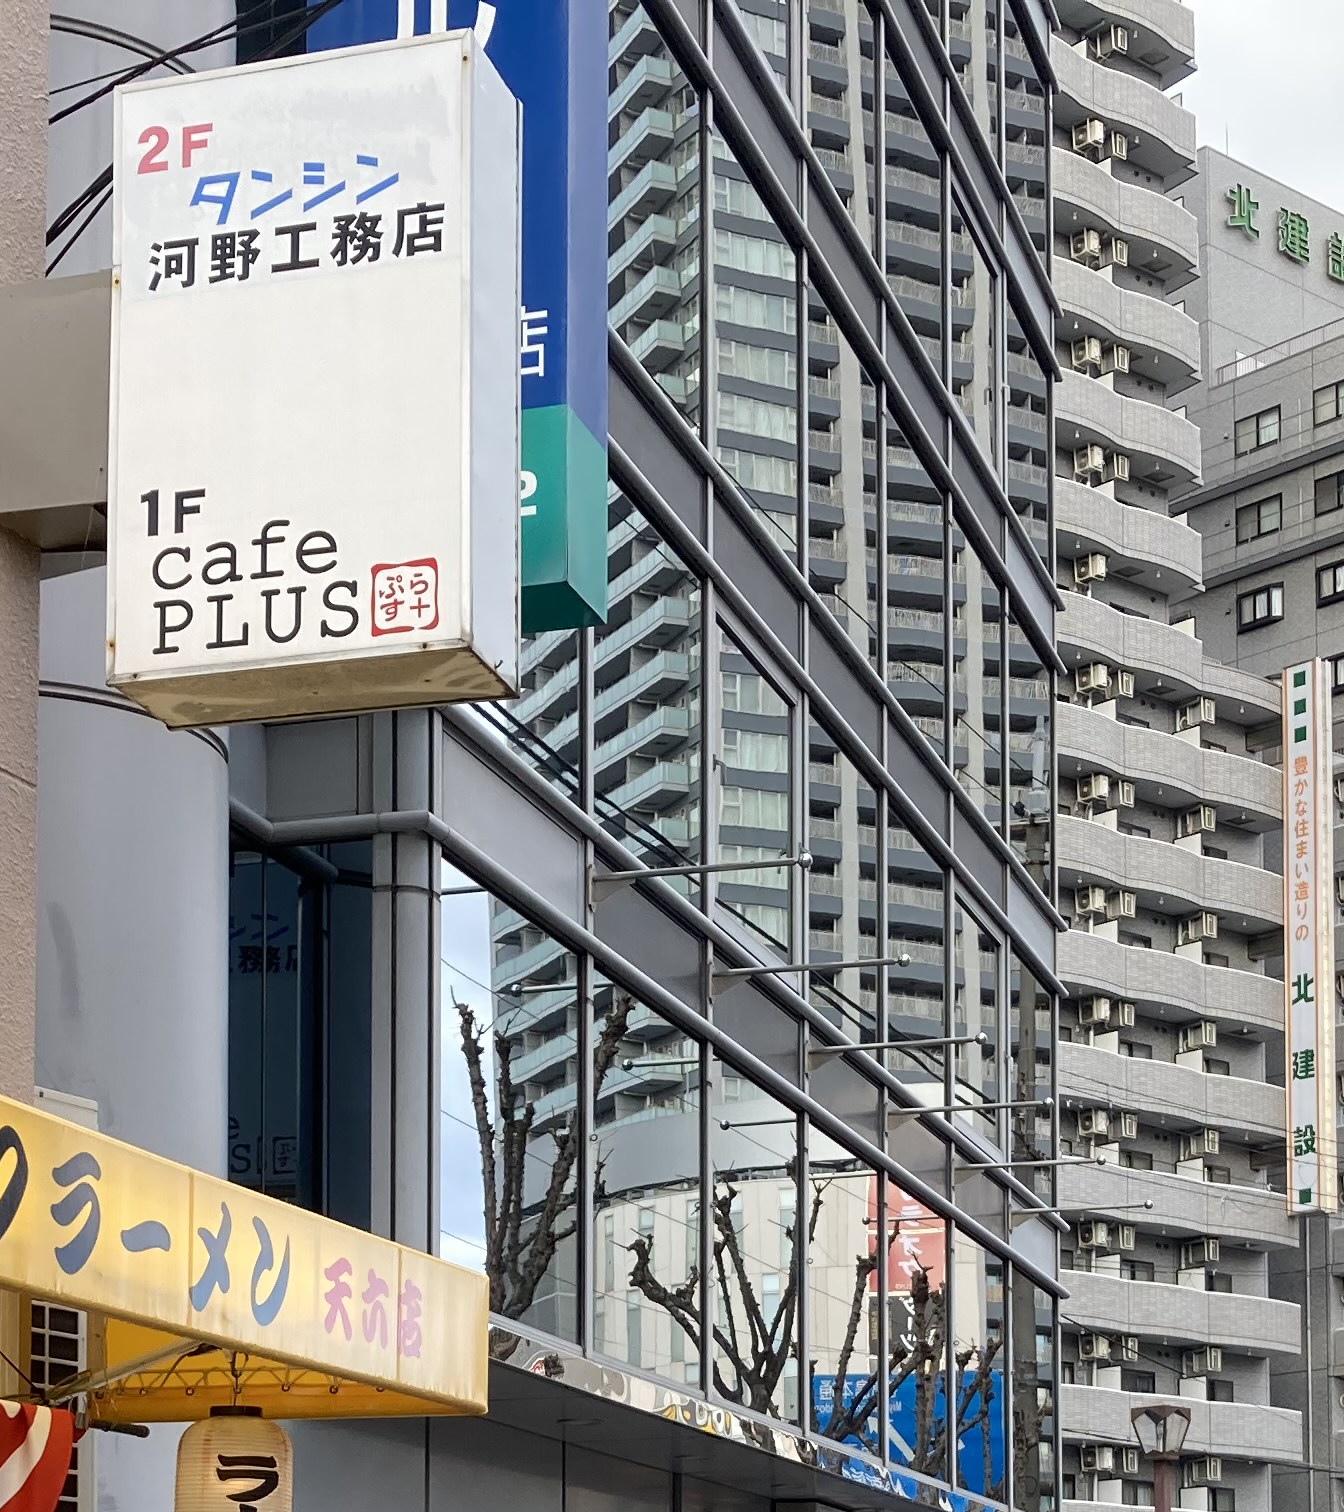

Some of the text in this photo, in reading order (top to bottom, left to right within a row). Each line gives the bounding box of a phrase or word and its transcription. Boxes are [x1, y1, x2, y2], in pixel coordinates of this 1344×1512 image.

[137, 122, 214, 175] 2F
[189, 153, 399, 225] タンシン
[148, 202, 446, 291] 河野工務店
[140, 487, 206, 537] 1F
[151, 518, 338, 591] cafe
[152, 579, 359, 655] PLUS
[1293, 757, 1310, 942] 豊かな住まい造りの
[1290, 974, 1317, 1157] 北建設
[322, 1257, 423, 1360] 天六店
